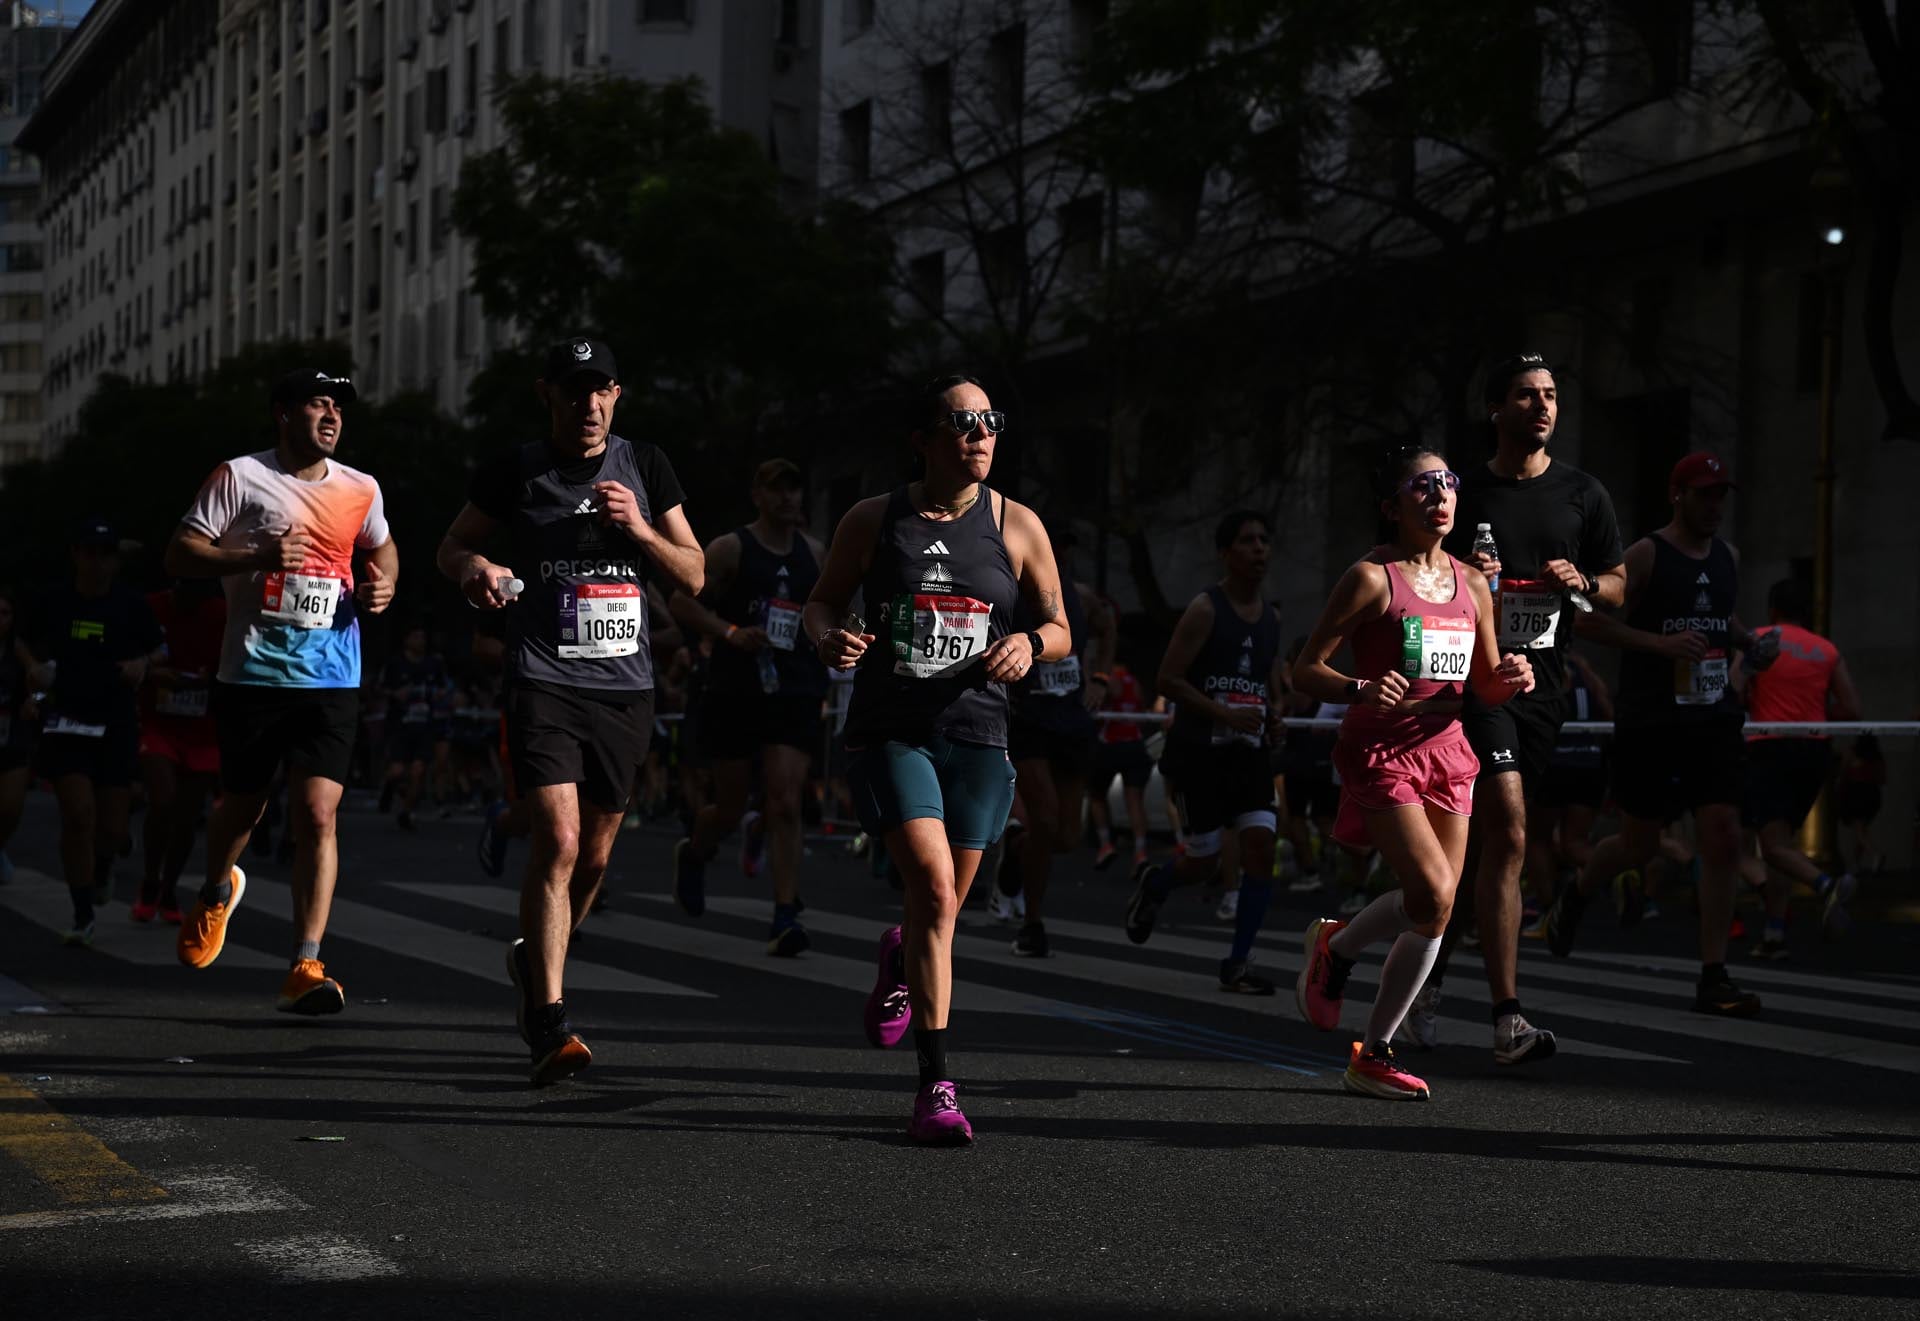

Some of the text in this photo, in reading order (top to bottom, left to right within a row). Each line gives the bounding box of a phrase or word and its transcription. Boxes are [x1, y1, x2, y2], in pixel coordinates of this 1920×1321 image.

[308, 580, 332, 591] MARTIN
[293, 593, 329, 614] 1461
[563, 593, 571, 608] F
[607, 602, 627, 612] DIEGO
[898, 603, 907, 620] E
[584, 619, 635, 640] 10635
[943, 617, 974, 628] VANINA
[1510, 612, 1552, 632] 3765
[1409, 624, 1417, 639] E
[923, 635, 974, 660] 8767
[1448, 635, 1461, 646] ANA
[1430, 652, 1466, 674] 8202
[1203, 675, 1265, 697] persona
